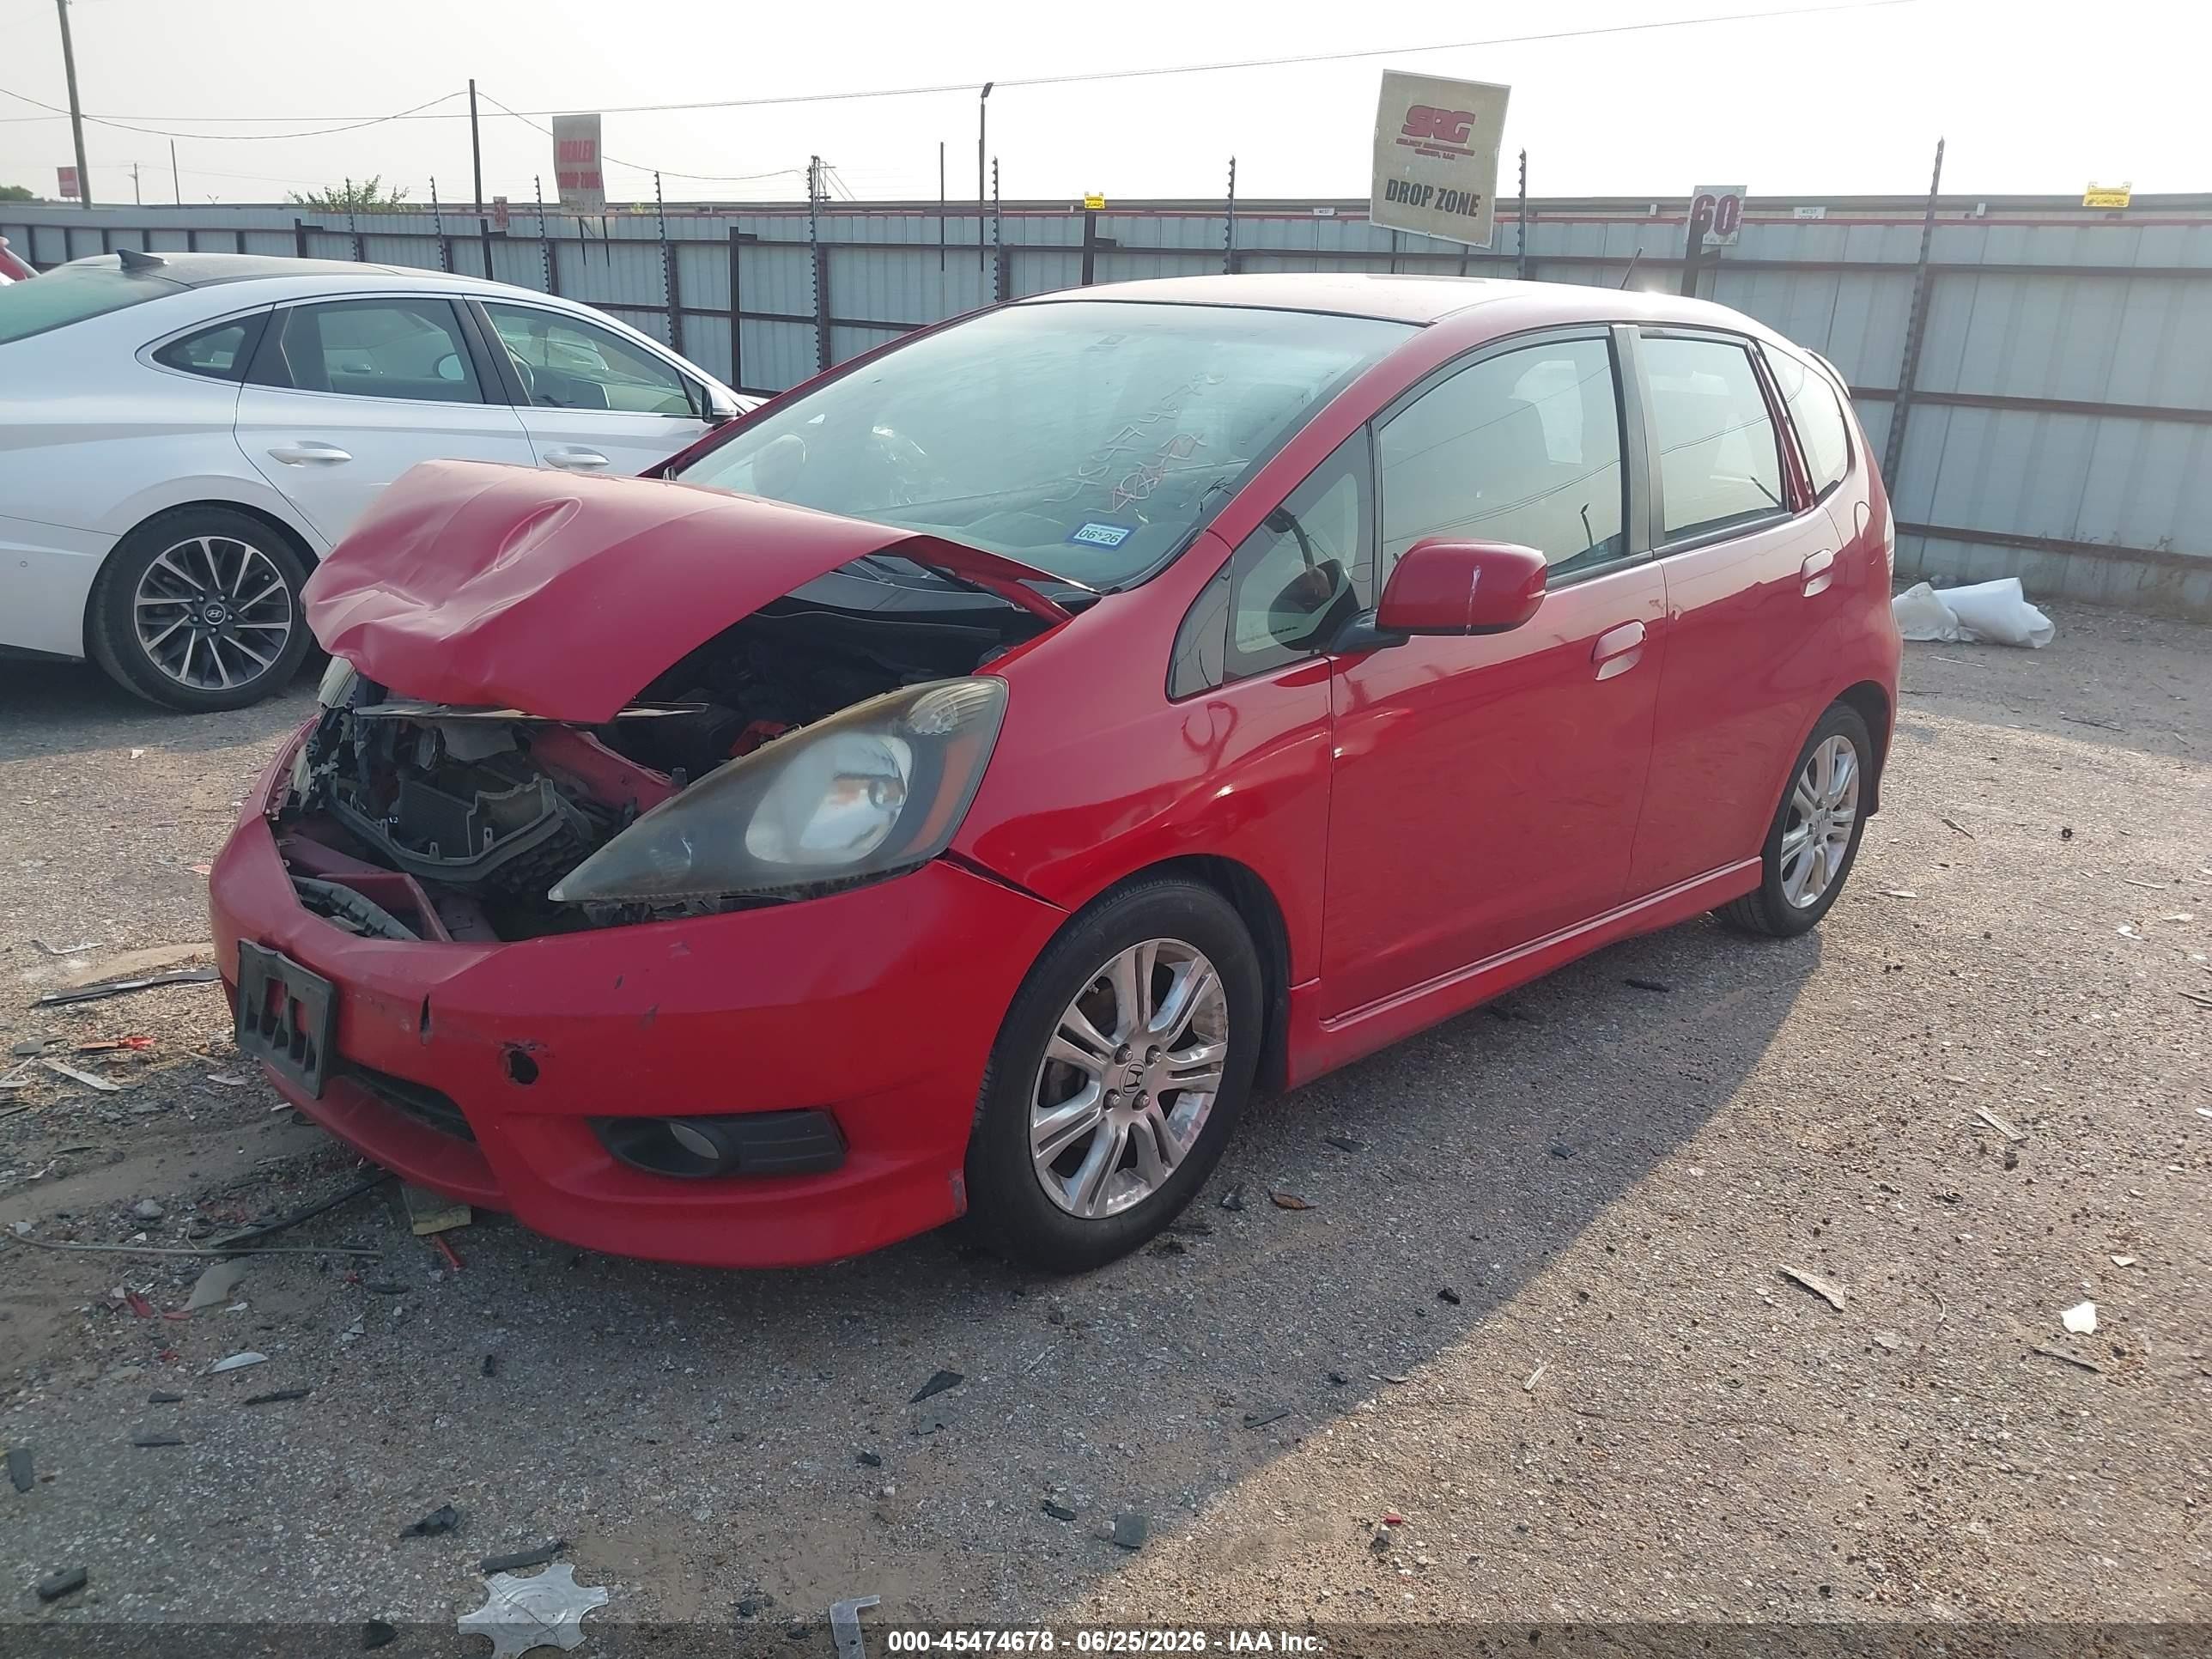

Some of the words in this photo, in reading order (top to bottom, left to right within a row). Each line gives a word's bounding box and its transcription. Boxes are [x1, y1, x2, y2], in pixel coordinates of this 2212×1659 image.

[1401, 104, 1476, 144] SRG
[1384, 179, 1434, 208] DROP
[1434, 187, 1481, 217] ZONE
[1692, 194, 1740, 235] 60
